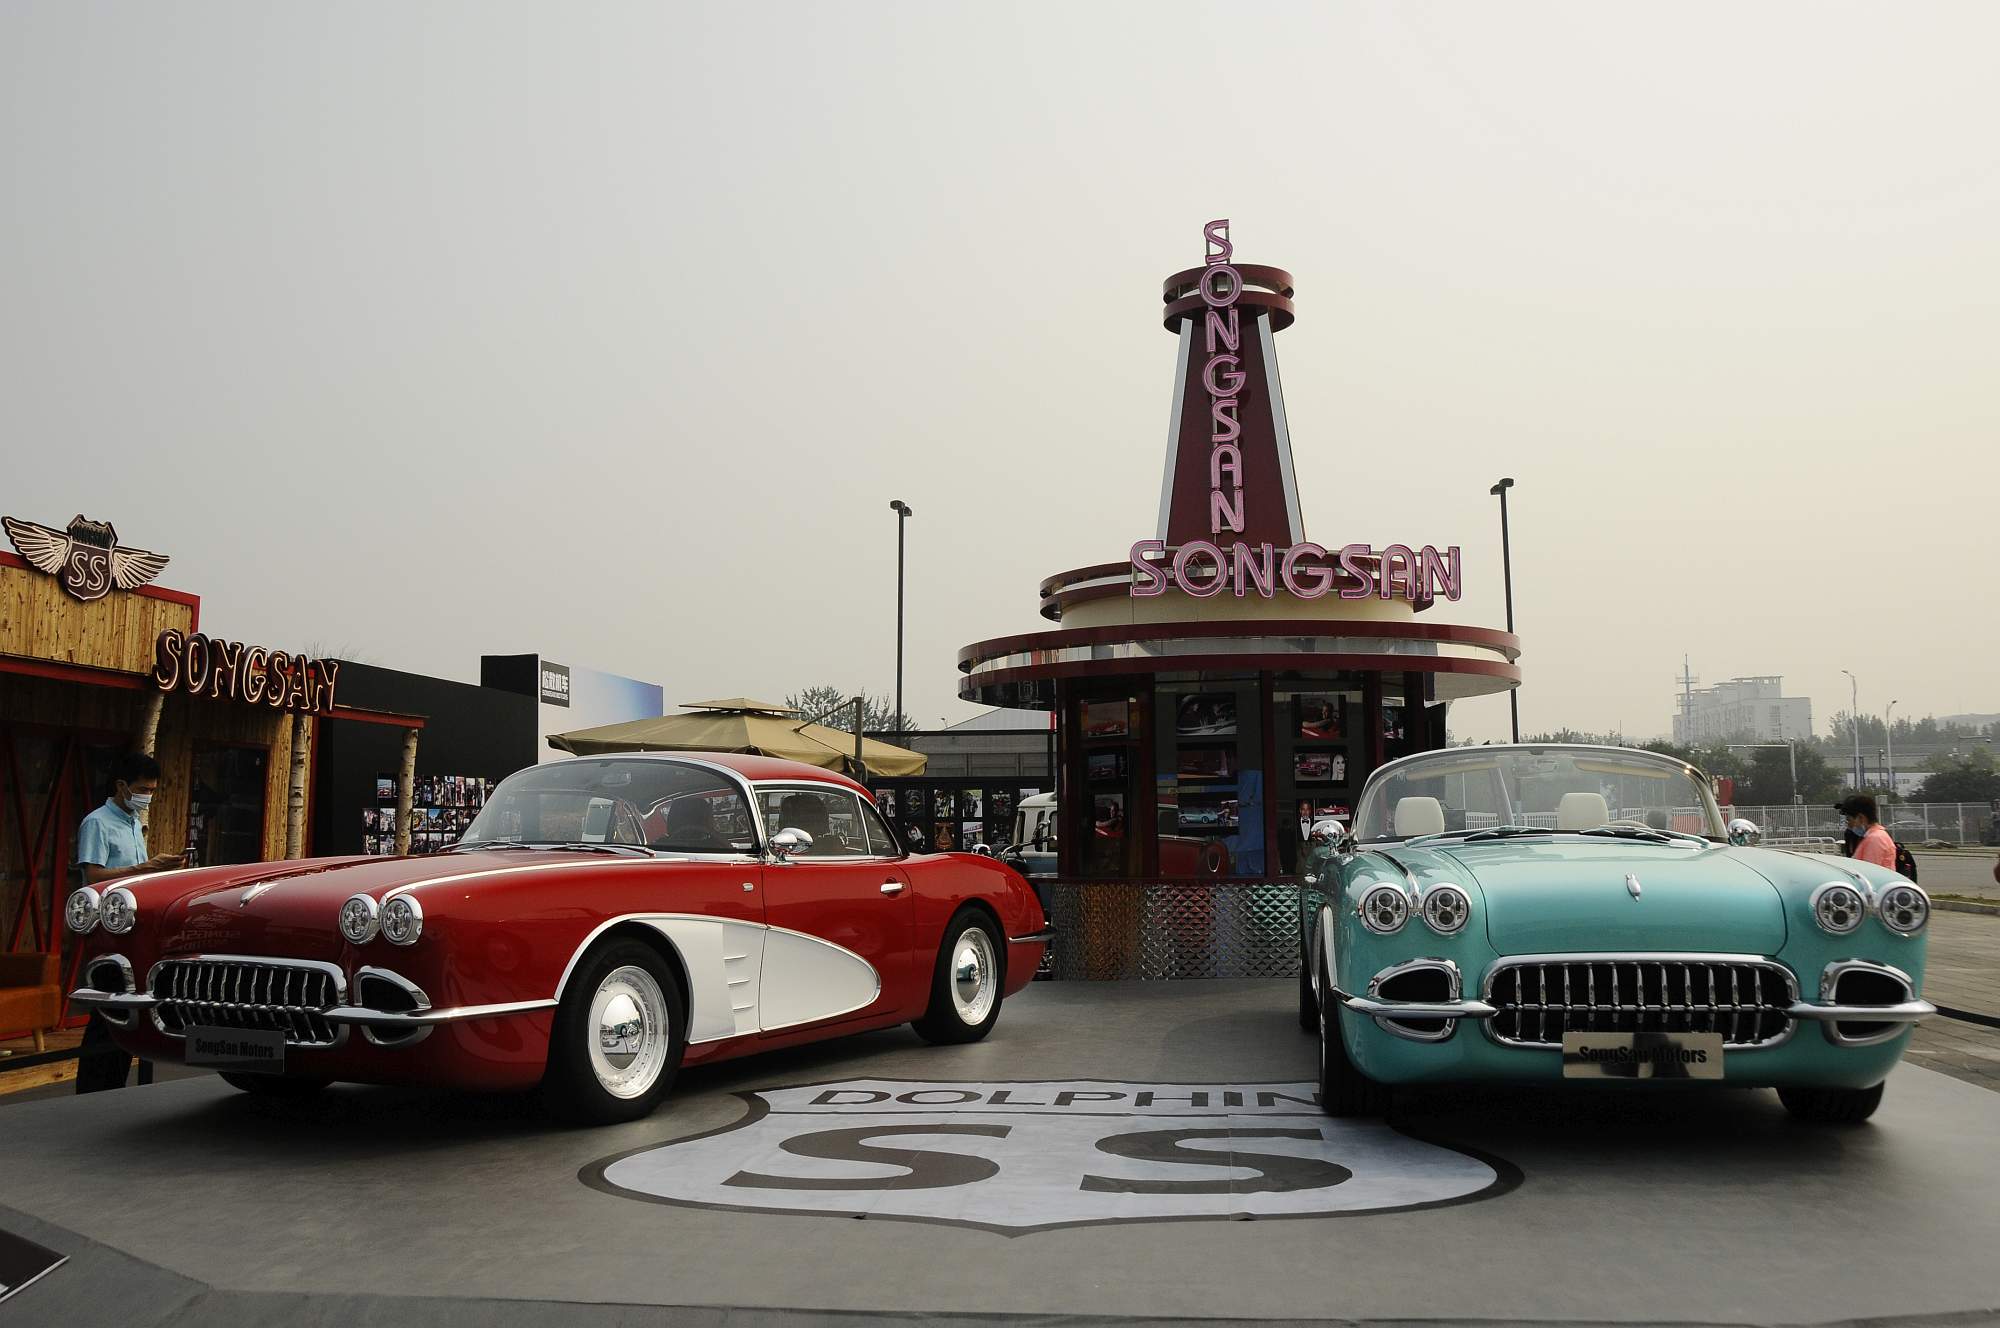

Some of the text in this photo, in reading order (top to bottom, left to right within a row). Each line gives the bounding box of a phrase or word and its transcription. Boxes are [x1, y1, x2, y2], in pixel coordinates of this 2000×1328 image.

[1200, 219, 1246, 533] SONGSAN
[67, 551, 108, 591] SS
[1130, 539, 1462, 601] SONGSAN
[154, 629, 339, 711] SONGSAN
[808, 1089, 1321, 1107] DOLPHIN
